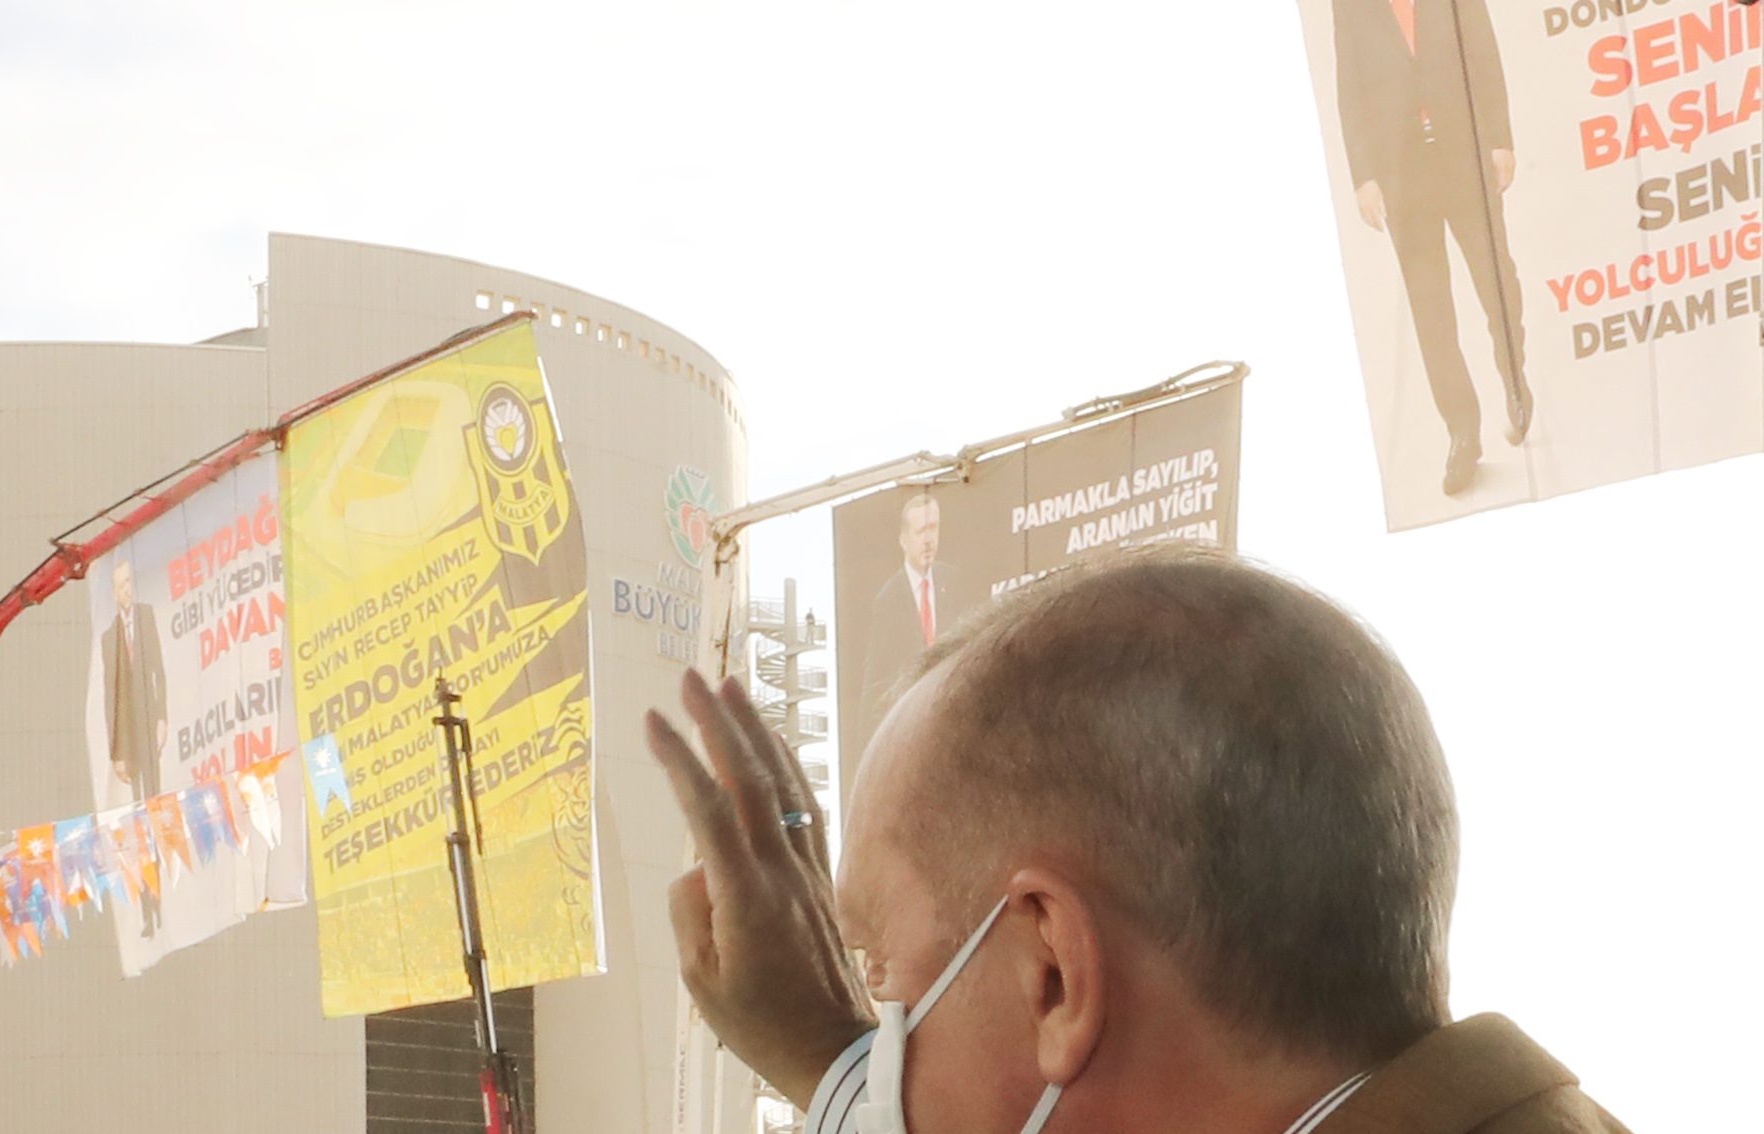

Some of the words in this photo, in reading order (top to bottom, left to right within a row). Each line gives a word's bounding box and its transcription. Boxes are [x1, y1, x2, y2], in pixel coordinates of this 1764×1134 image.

[1545, 211, 1761, 313] YOLCULUĞ
[1572, 288, 1716, 360] DEVAM
[1011, 475, 1131, 535] PARMAKLA
[1132, 447, 1220, 497] SAYILIP,
[1065, 500, 1155, 555] ARANAN
[1159, 480, 1219, 523] YİĞİT
[171, 591, 204, 640] GİBİ
[302, 647, 349, 691] SAYIN
[353, 612, 412, 661] RECEP
[414, 572, 479, 624] TAYYİP
